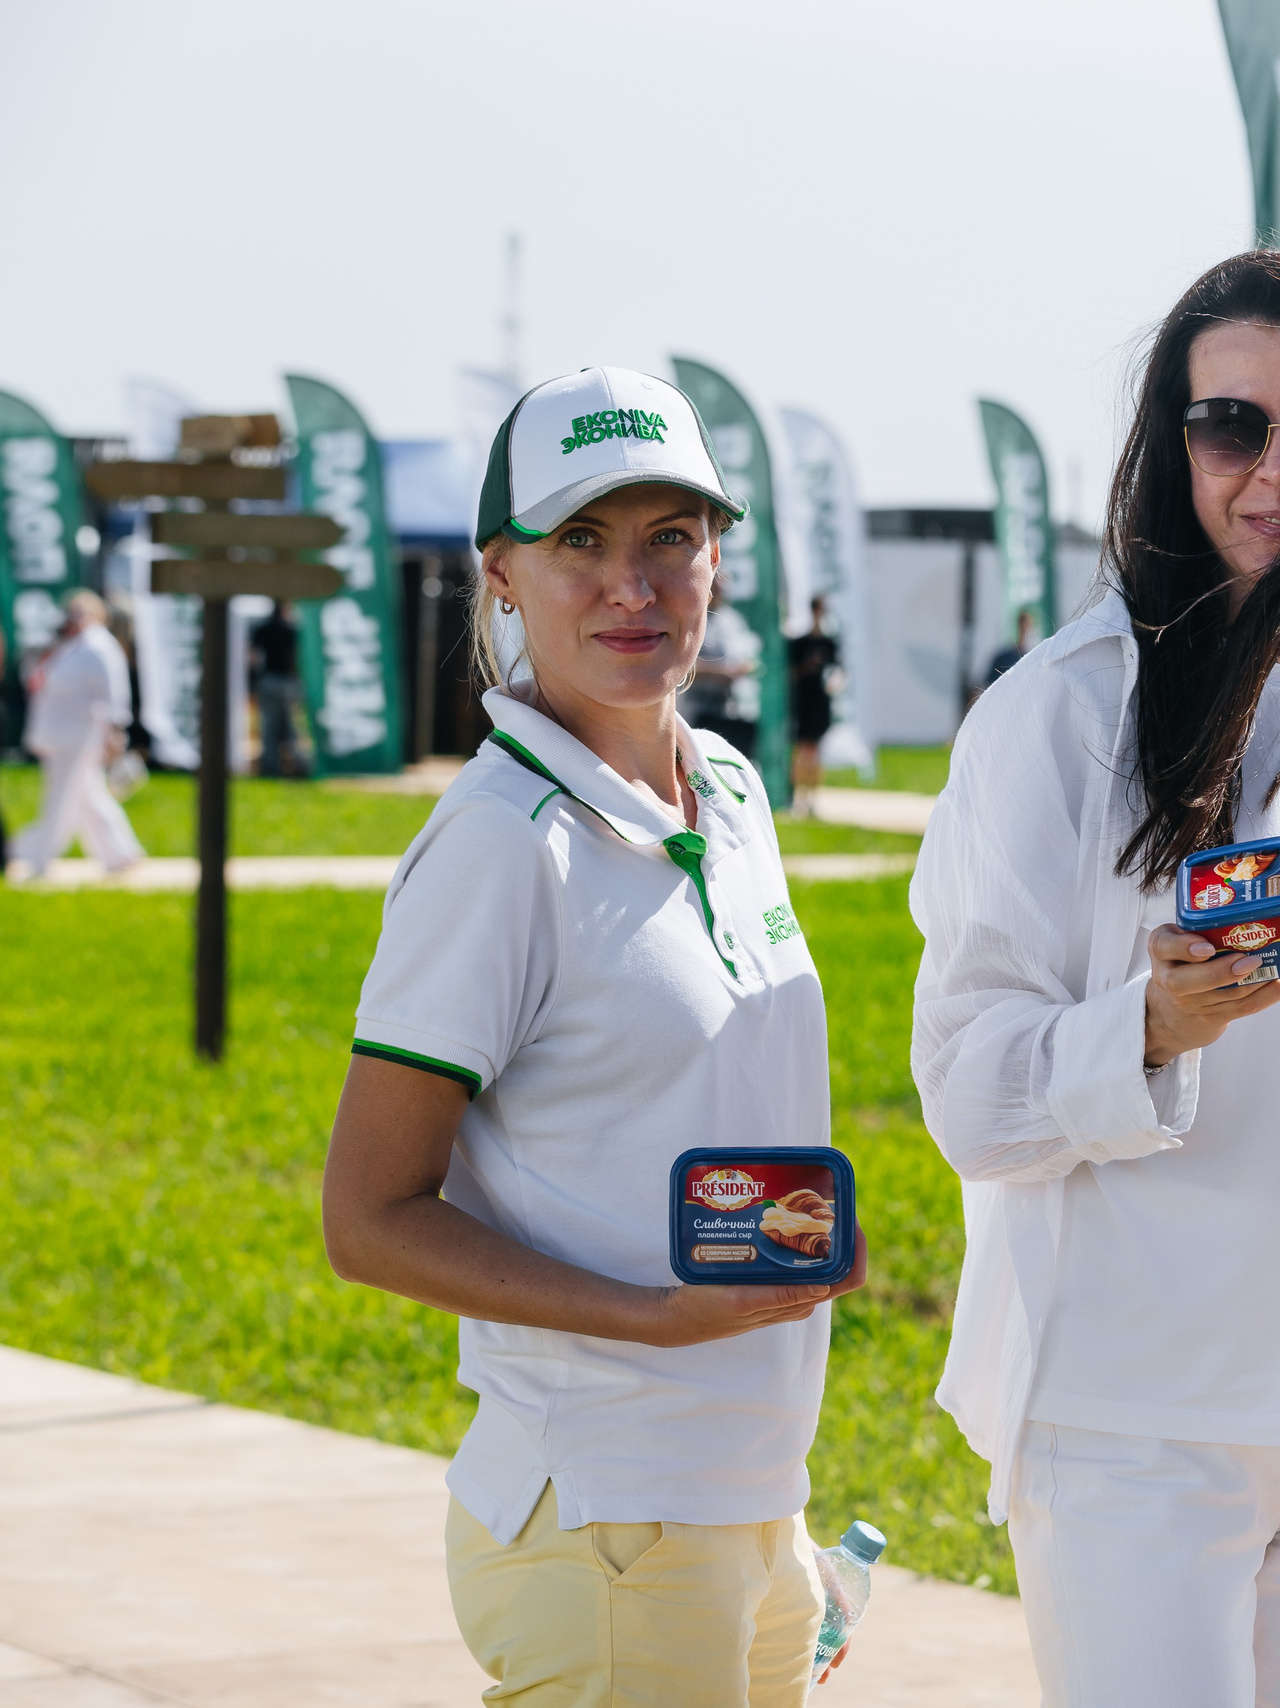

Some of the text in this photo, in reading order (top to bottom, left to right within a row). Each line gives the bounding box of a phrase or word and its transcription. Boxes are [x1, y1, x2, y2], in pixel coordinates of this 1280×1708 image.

[571, 408, 668, 432] EKONIVA
[560, 423, 665, 455] ЭКОНИВА
[1223, 927, 1276, 946] PRÉSIDENT
[693, 1180, 764, 1198] PRÉSIDENT
[694, 1217, 756, 1230] Сливочный
[738, 1232, 752, 1240] сыр
